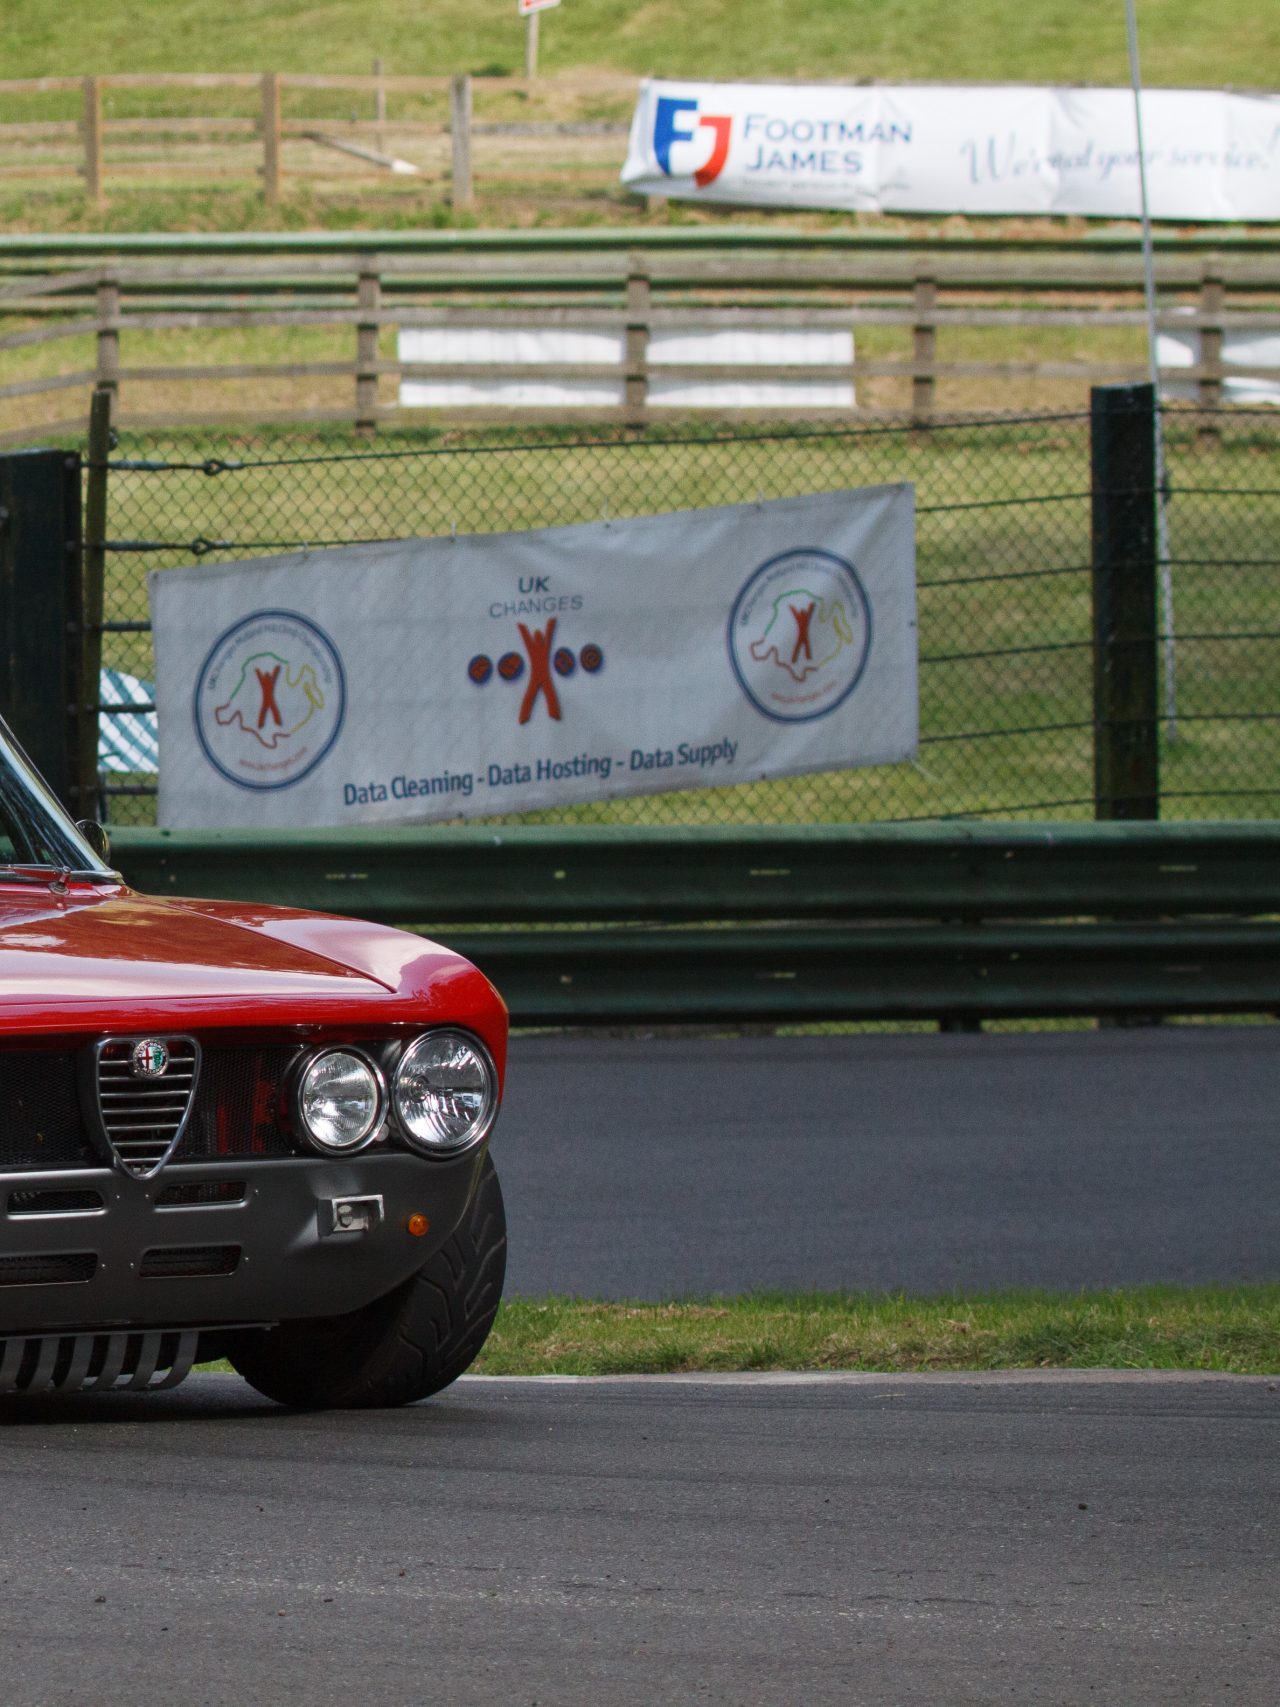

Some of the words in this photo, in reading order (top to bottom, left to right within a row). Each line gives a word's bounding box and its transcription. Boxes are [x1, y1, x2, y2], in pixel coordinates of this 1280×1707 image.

[743, 113, 912, 144] FOOTMAN
[745, 146, 863, 173] JAMES
[518, 575, 550, 594] UK
[489, 594, 584, 618] CHANGES
[343, 782, 388, 806] Data
[391, 769, 474, 800] Cleaning
[488, 762, 532, 787] Data
[536, 752, 612, 781] Hosting
[630, 747, 674, 771] Data
[677, 736, 739, 767] Supply
